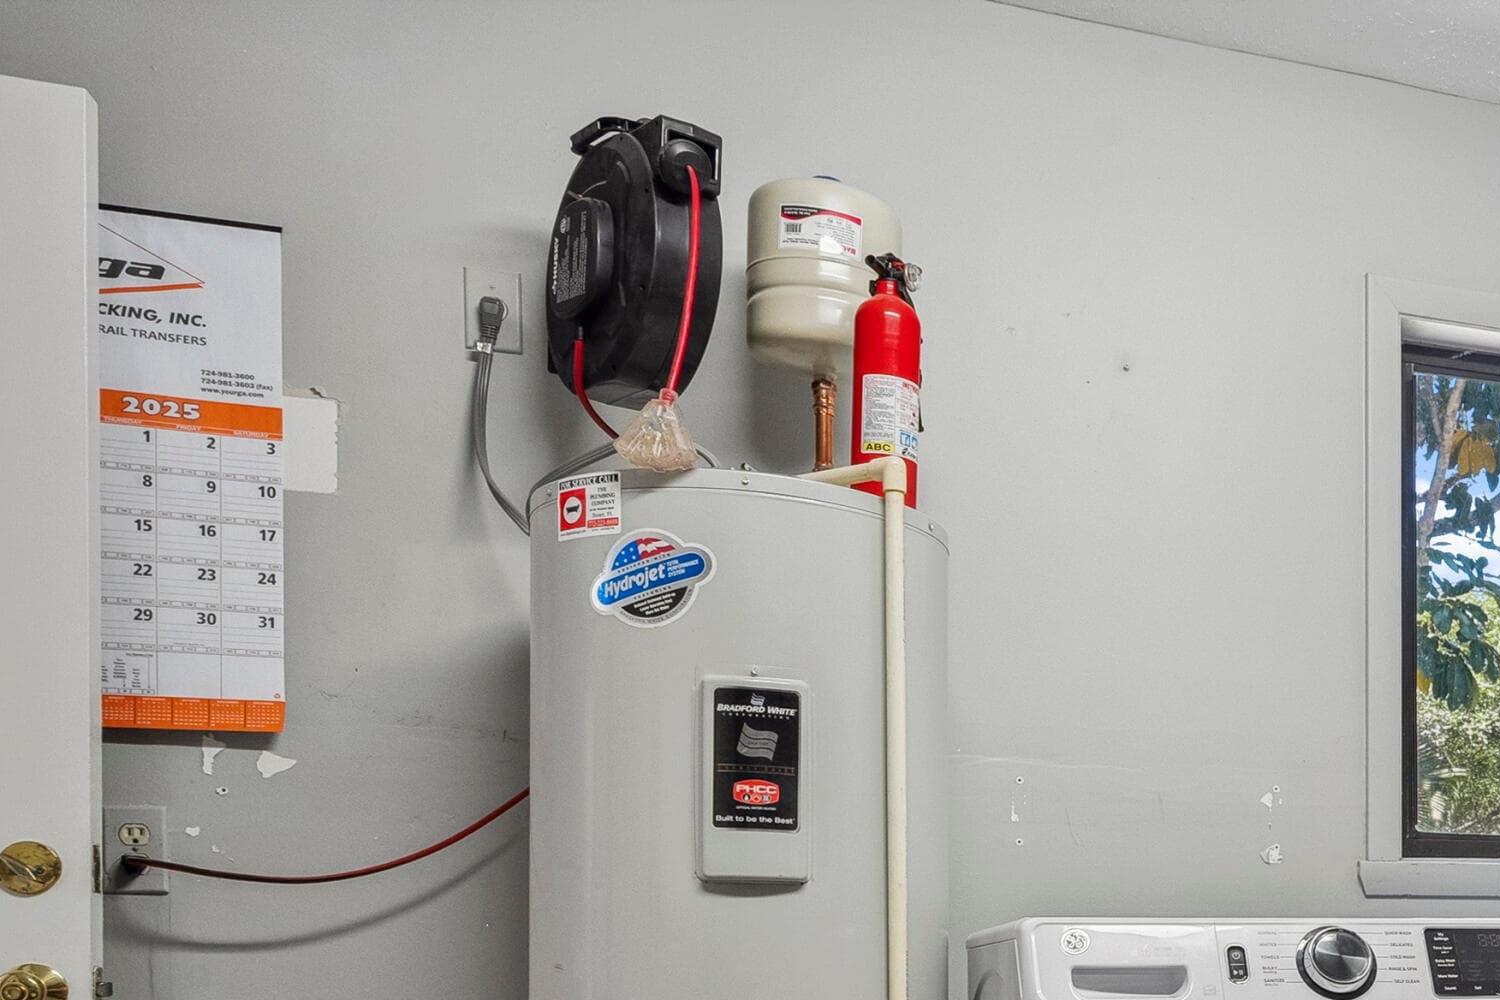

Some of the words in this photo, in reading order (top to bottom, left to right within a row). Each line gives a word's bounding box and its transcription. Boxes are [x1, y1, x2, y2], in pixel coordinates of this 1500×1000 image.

[169, 312, 207, 327] INC.
[131, 328, 207, 346] TRANSFERS
[200, 369, 255, 380] 724-981-3600
[121, 396, 201, 420] 2025
[143, 430, 150, 442] 1
[206, 437, 216, 449] 2
[266, 443, 276, 455] 3
[866, 443, 891, 452] ABC
[142, 474, 153, 487] 8
[206, 481, 217, 493] 9
[258, 485, 277, 498] 10
[134, 519, 153, 532] 15
[198, 524, 217, 537] 16
[259, 529, 277, 542] 17
[133, 563, 153, 576] 22
[197, 568, 217, 581] 23
[257, 572, 277, 585] 24
[604, 564, 666, 599] Hydrojet
[133, 608, 153, 621] 29
[196, 612, 217, 625] 30
[258, 616, 276, 629] 31
[717, 703, 765, 713] BRADFORD
[767, 706, 796, 716] WHITE
[736, 784, 777, 794] PHCC
[715, 814, 734, 822] Built
